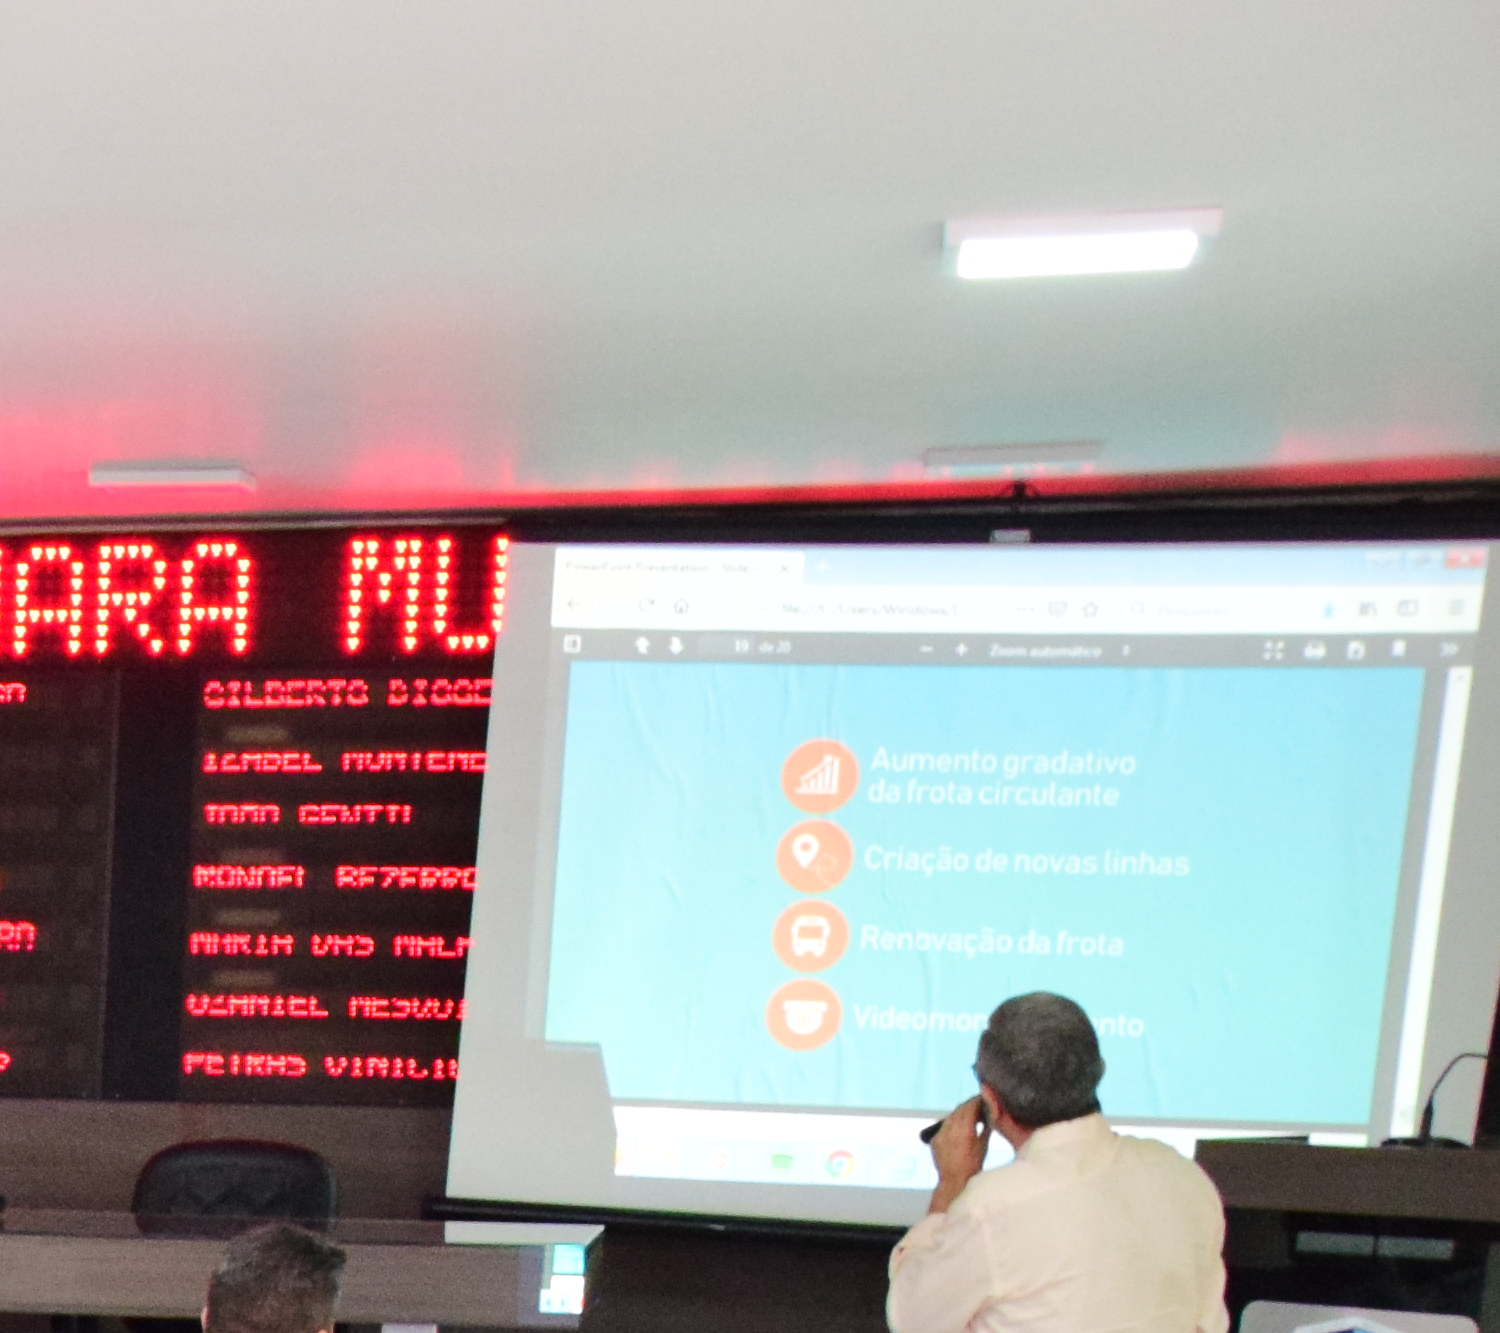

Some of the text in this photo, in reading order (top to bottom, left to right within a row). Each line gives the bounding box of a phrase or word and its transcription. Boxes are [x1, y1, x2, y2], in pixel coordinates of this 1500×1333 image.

[872, 746, 1136, 780] Aumento gradativo
[868, 778, 1119, 807] da frota circulante
[865, 845, 1190, 877] Criação de novas linhas
[861, 925, 1125, 958] Renovação da frota
